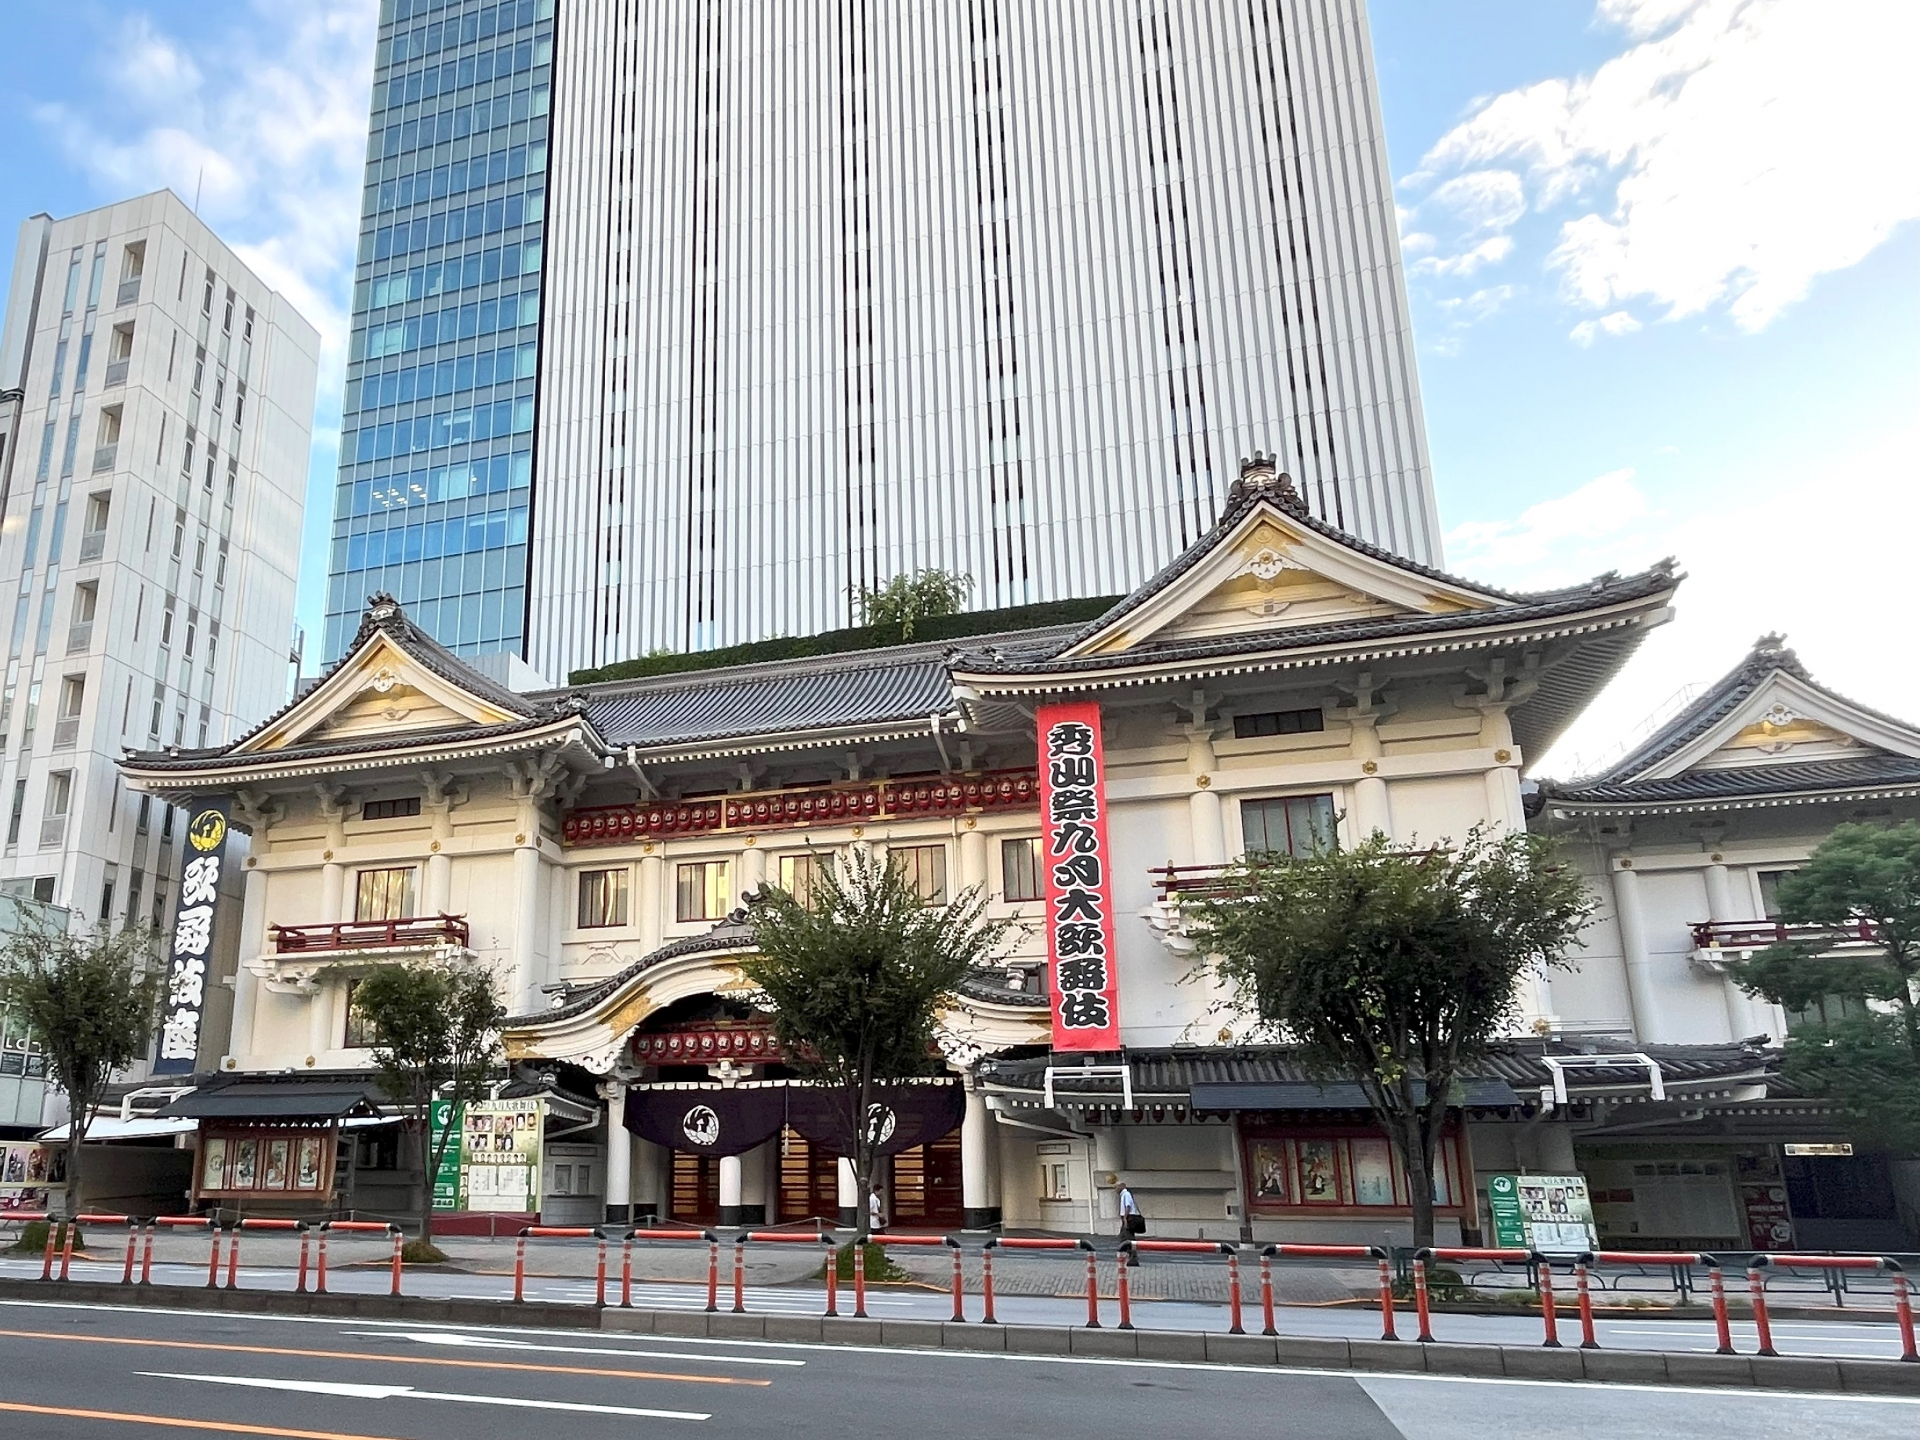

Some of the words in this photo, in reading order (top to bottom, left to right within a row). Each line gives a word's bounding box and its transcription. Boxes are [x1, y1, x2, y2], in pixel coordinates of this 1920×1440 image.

[161, 856, 220, 1060] 歌舞伎座
[1047, 722, 1109, 1029] 秀山祭九月大歌舞伎
